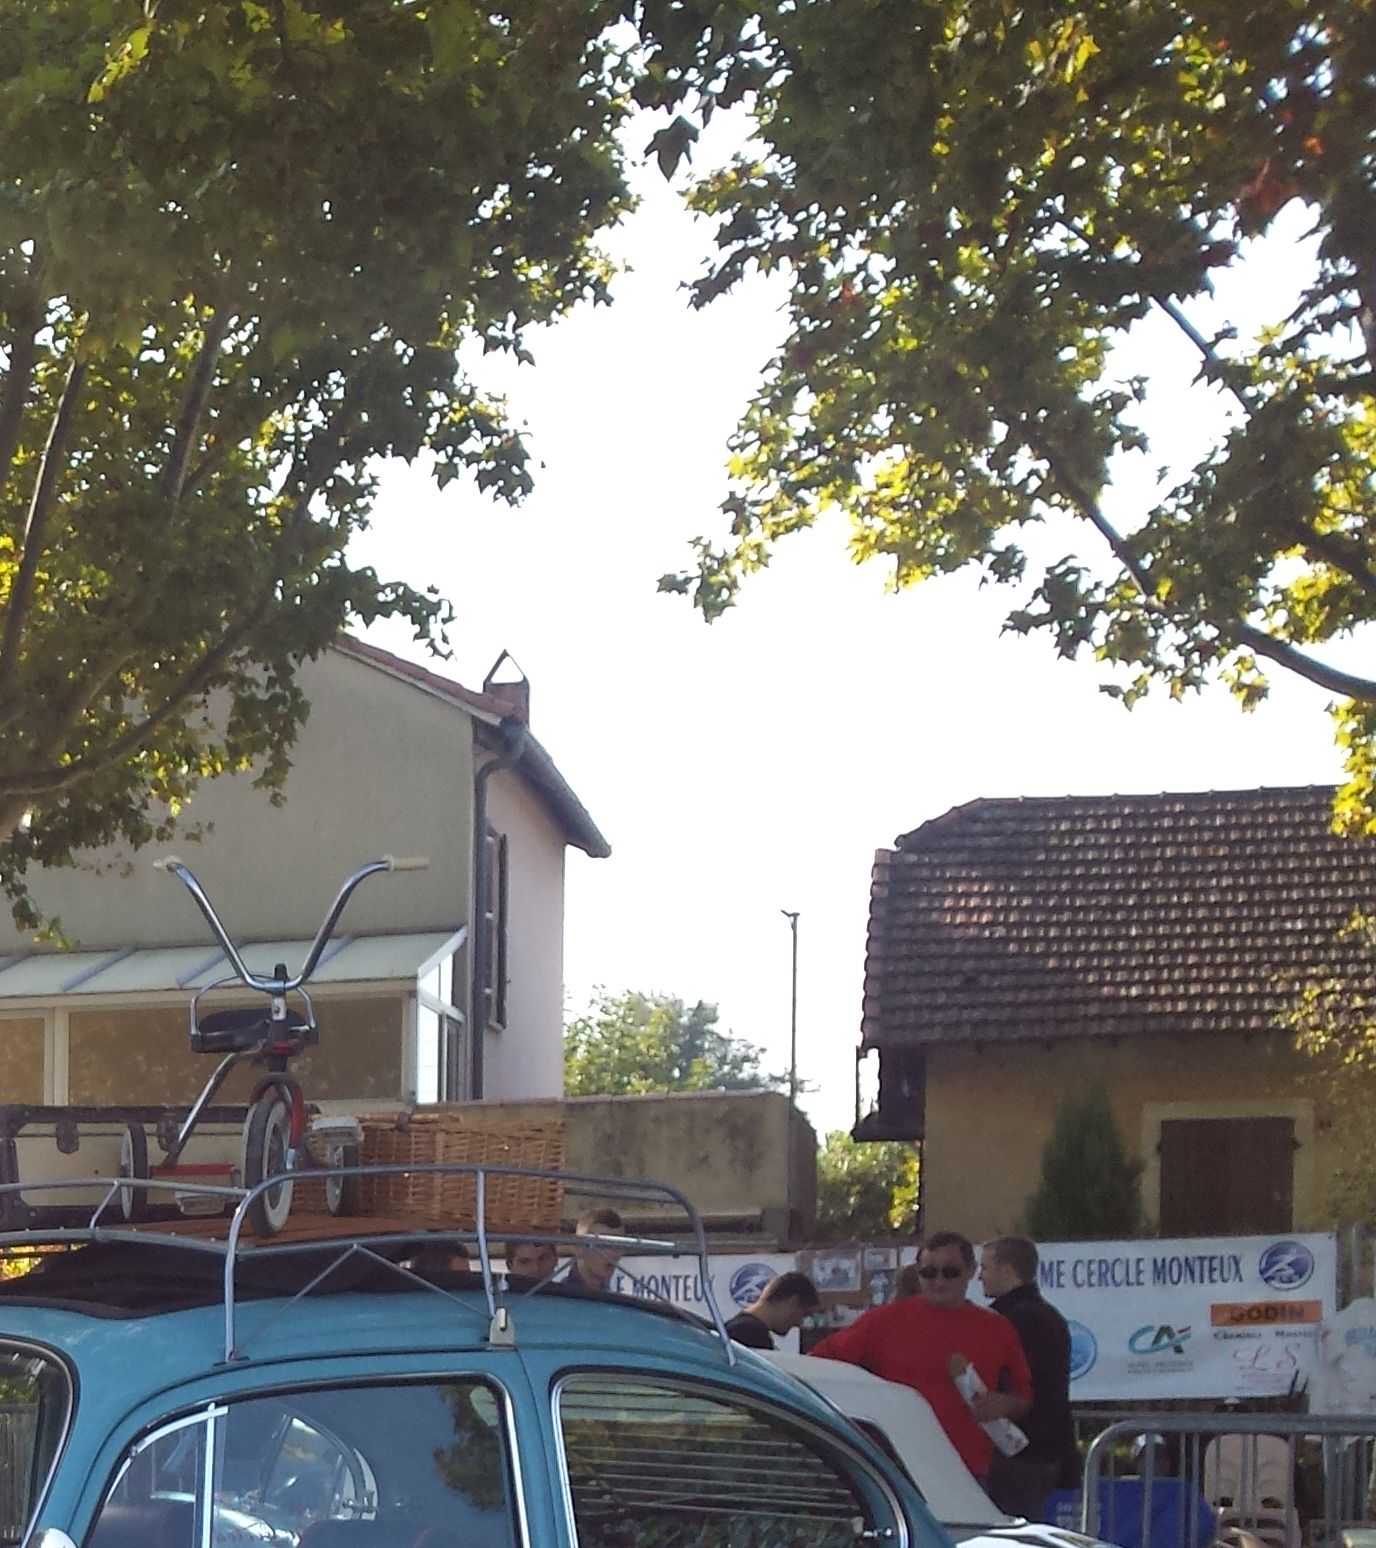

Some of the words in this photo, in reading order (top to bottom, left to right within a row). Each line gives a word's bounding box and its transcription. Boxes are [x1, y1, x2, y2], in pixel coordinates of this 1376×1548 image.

[1039, 1260, 1066, 1289] ME
[1072, 1256, 1145, 1288] CERCLE
[1152, 1254, 1245, 1286] MONTEUX
